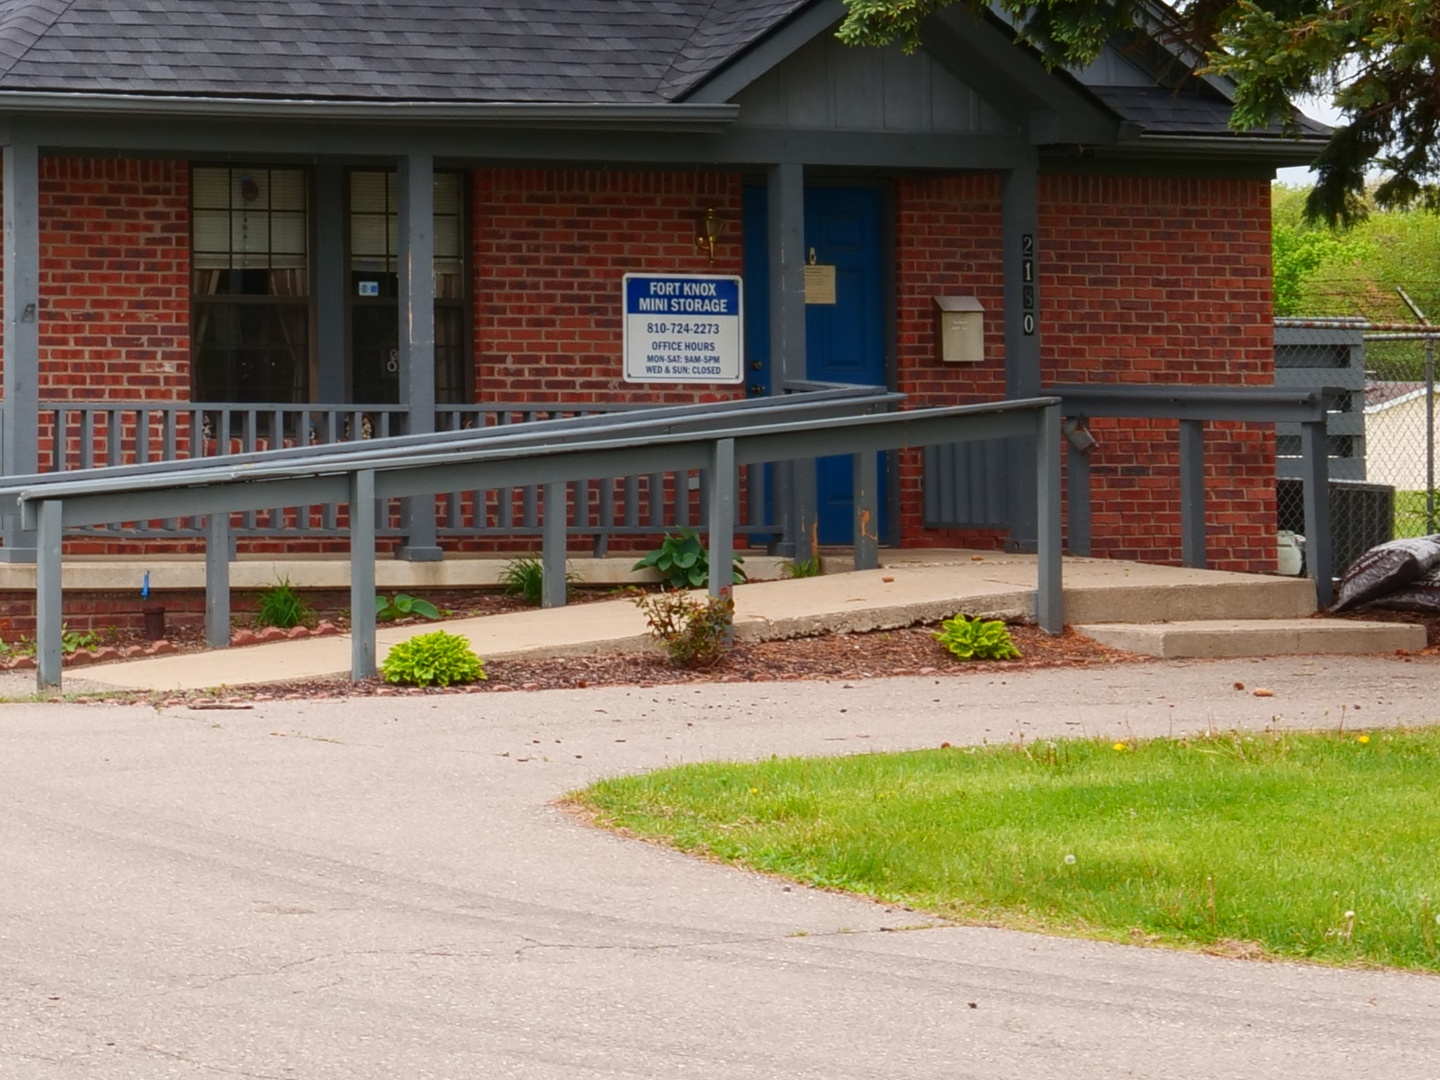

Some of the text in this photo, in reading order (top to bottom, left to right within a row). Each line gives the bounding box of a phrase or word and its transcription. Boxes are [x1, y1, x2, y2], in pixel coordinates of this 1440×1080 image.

[650, 282, 716, 296] FORT KNOX
[639, 298, 728, 312] MINI STORAGE
[647, 322, 719, 334] 810-724-2273
[652, 341, 715, 351] OFFICE HOURS
[646, 366, 721, 374] WED & SUN: CLOSED
